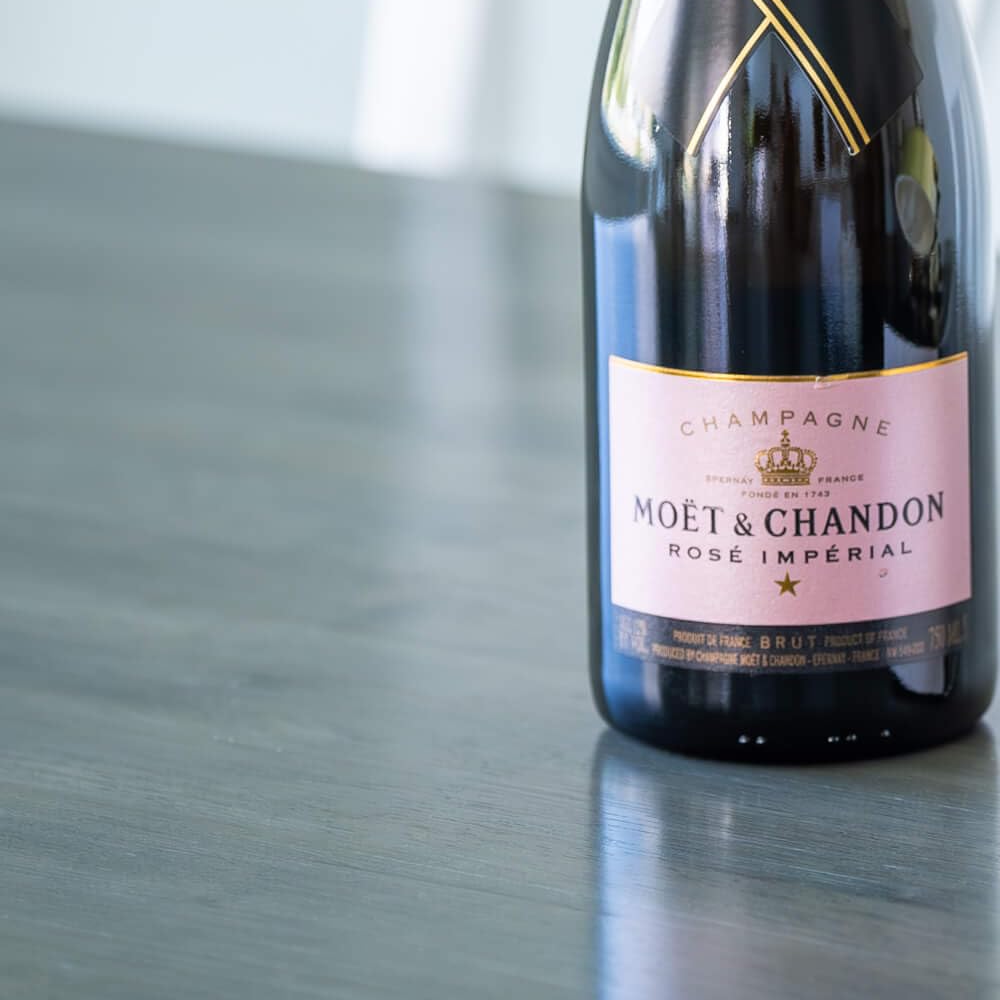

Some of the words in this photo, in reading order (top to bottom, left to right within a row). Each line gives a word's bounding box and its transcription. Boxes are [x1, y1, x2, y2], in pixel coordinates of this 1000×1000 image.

[680, 410, 892, 437] CHAMPAGNE
[818, 474, 865, 484] FRANCE
[784, 491, 799, 499] EN
[805, 490, 831, 499] 1743
[634, 495, 724, 535] MOËT
[733, 512, 755, 537] &
[764, 491, 944, 537] CHANDON
[669, 543, 743, 563] ROSÉ
[762, 541, 912, 564] IMPÉRIAL
[760, 634, 816, 649] BRUT
